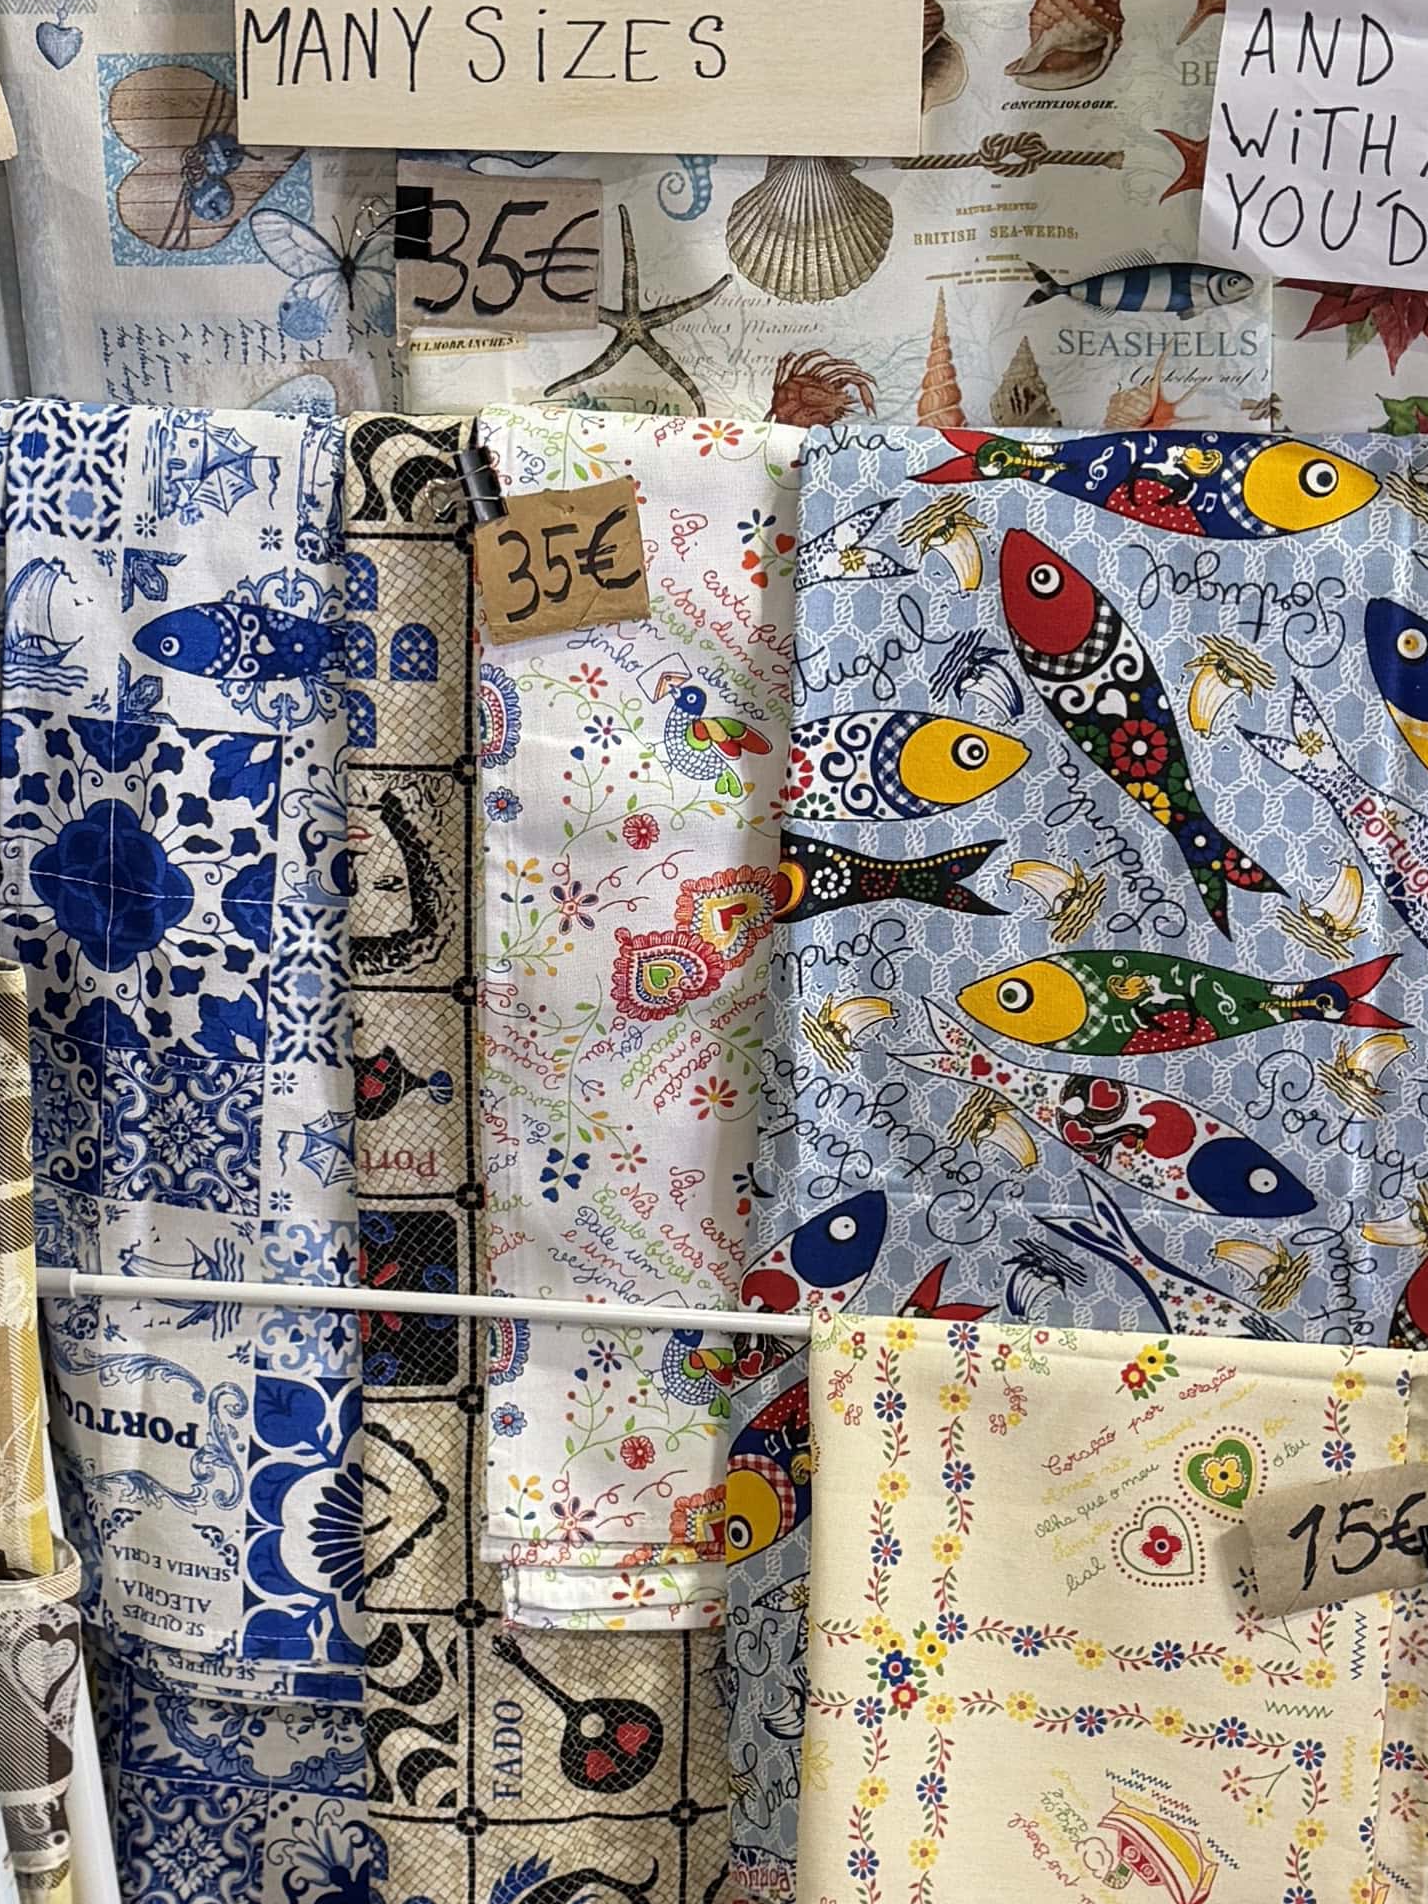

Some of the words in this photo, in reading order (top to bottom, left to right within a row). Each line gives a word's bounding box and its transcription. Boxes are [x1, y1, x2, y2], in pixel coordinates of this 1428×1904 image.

[242, 5, 432, 100] MANY
[1240, 7, 1397, 89] AND
[413, 198, 601, 315] 35€
[914, 228, 977, 247] BRITISH
[1058, 328, 1259, 358] SEASHELLS
[497, 502, 643, 624] 35€
[1128, 543, 1349, 669] Portugal
[792, 594, 959, 708] tugal
[56, 1400, 199, 1452] PORTUG
[1127, 1403, 1165, 1435] por
[1286, 1491, 1428, 1592] 15€
[122, 1603, 182, 1632] QUERES
[185, 1621, 205, 1637] SE
[492, 1698, 524, 1802] FADO
